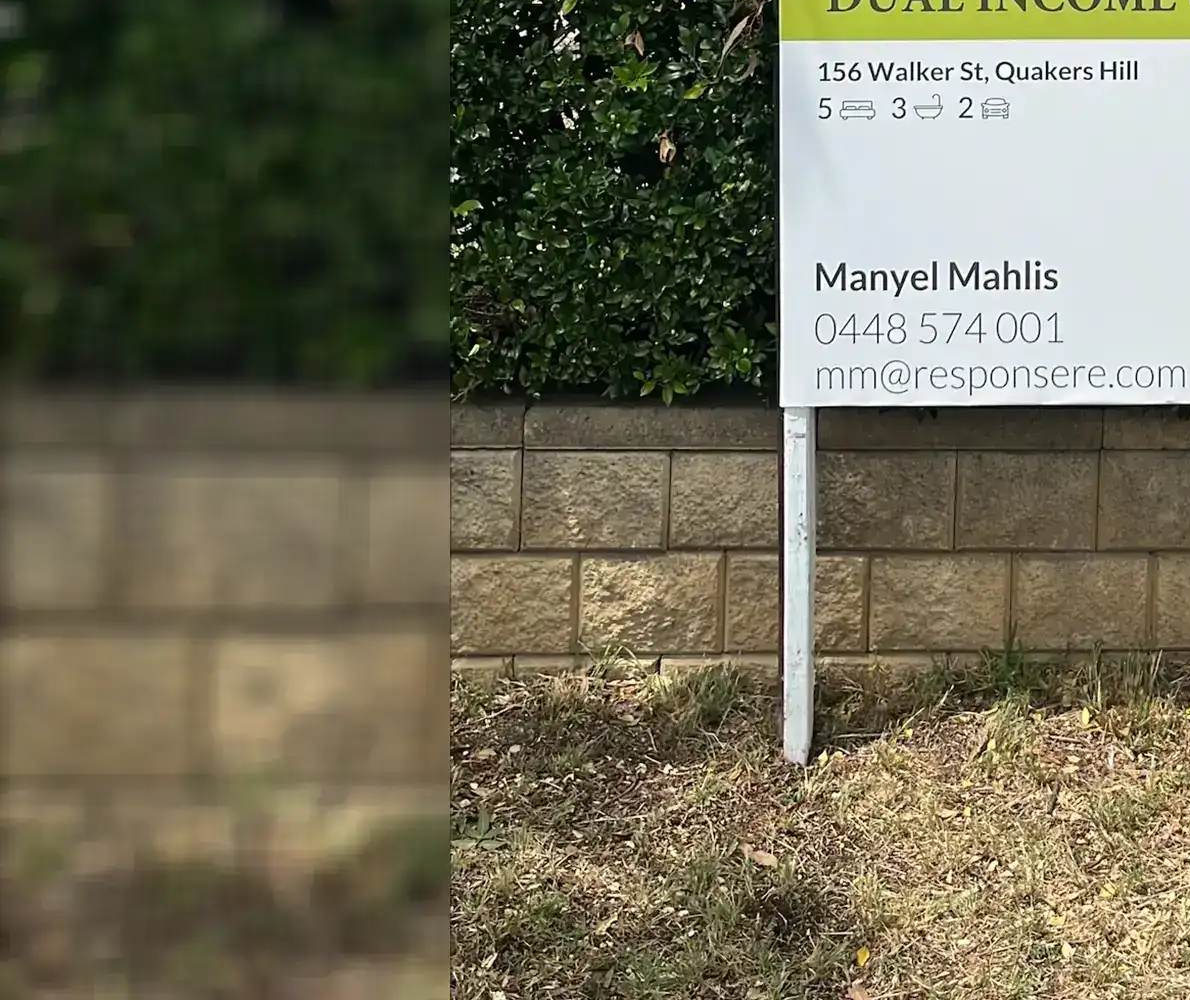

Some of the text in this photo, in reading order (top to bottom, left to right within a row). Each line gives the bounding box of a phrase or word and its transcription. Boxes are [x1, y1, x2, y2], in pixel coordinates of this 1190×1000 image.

[818, 60, 1139, 84] 156 Walker St, Quakers Hill
[818, 97, 973, 119] 5 3 2
[815, 260, 1059, 297] Manyel Mahlis
[814, 312, 1064, 345] 0448 574 001
[816, 360, 1186, 394] mm@responsere.com
